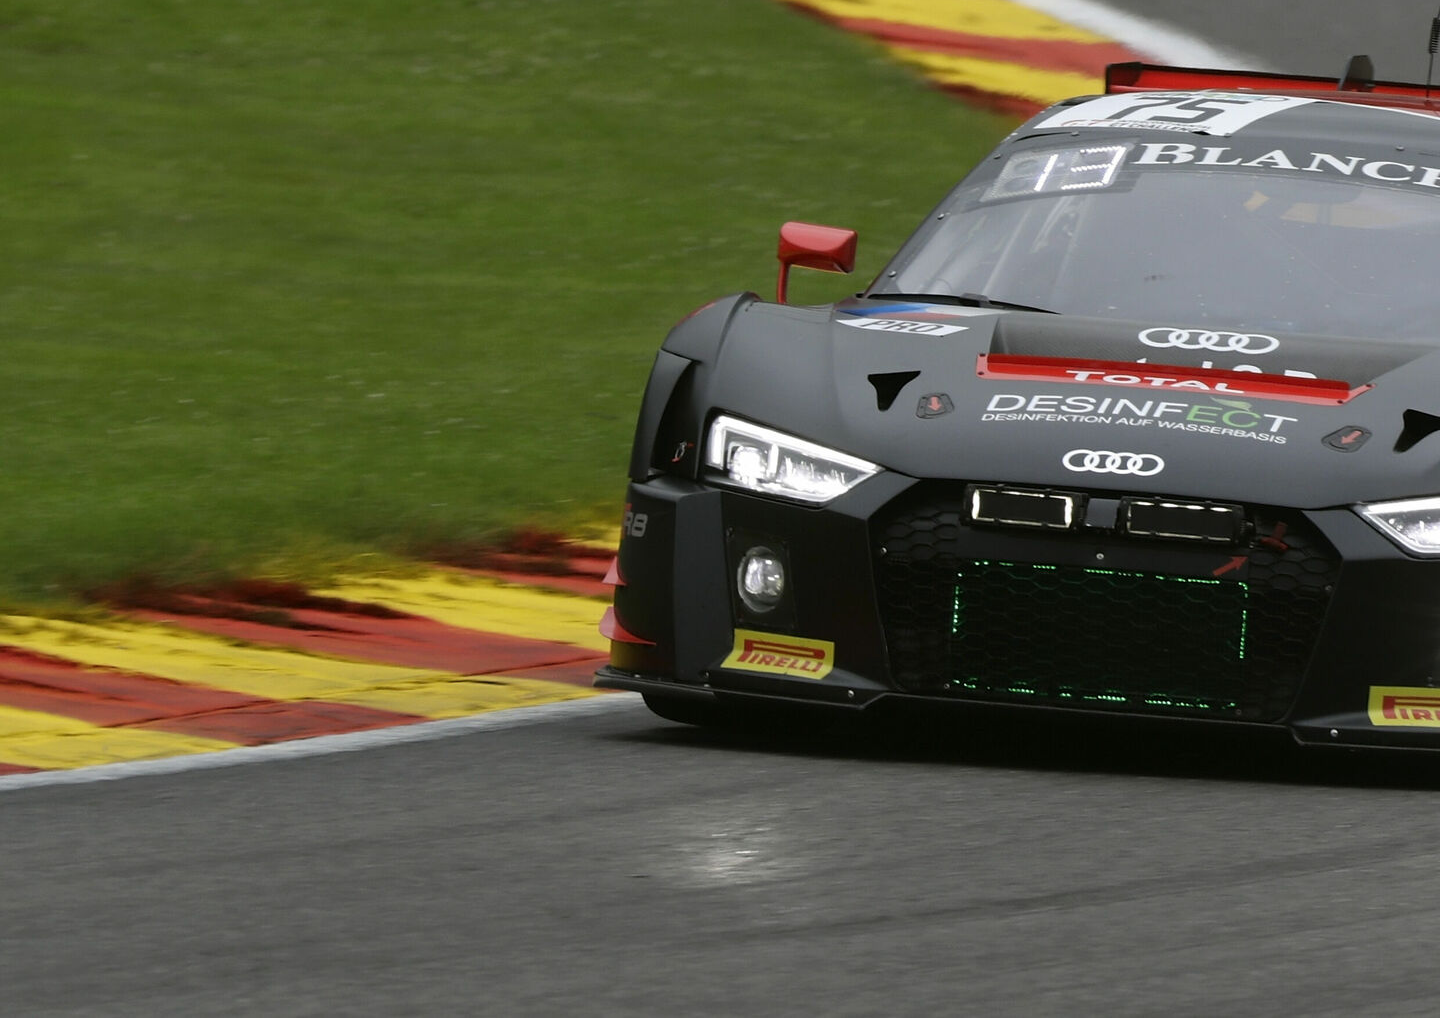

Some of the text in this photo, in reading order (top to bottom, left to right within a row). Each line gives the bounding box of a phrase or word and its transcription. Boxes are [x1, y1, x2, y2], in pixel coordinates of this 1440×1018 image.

[1105, 96, 1252, 124] 75
[860, 320, 942, 333] PRO
[1065, 369, 1245, 394] TOTAL
[980, 412, 1288, 445] DESINFEKTION AUF WASSERBASIS
[985, 393, 1299, 434] DESINFECT
[736, 638, 826, 673] PIRELLI
